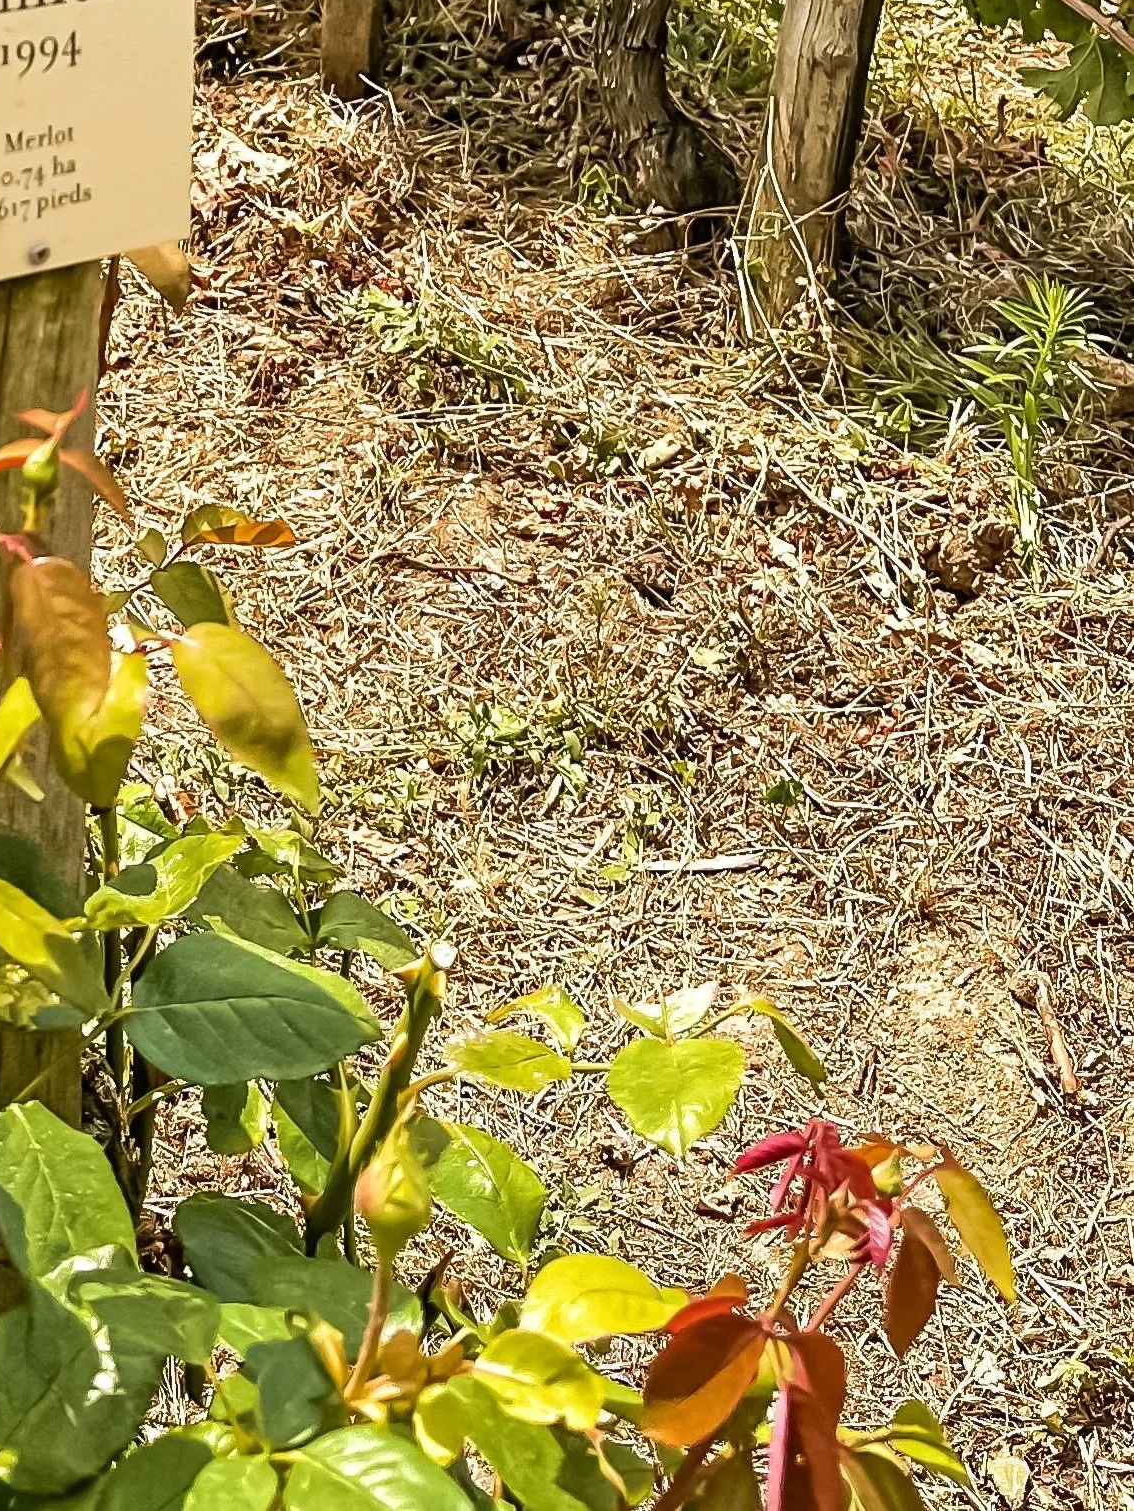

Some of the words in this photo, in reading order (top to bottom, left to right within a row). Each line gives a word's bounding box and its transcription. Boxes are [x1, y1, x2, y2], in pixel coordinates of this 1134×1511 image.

[0, 29, 82, 80] 1994
[4, 124, 74, 154] Merlot
[0, 164, 44, 190] 0.74
[52, 155, 76, 177] ha
[36, 182, 92, 219] pieds
